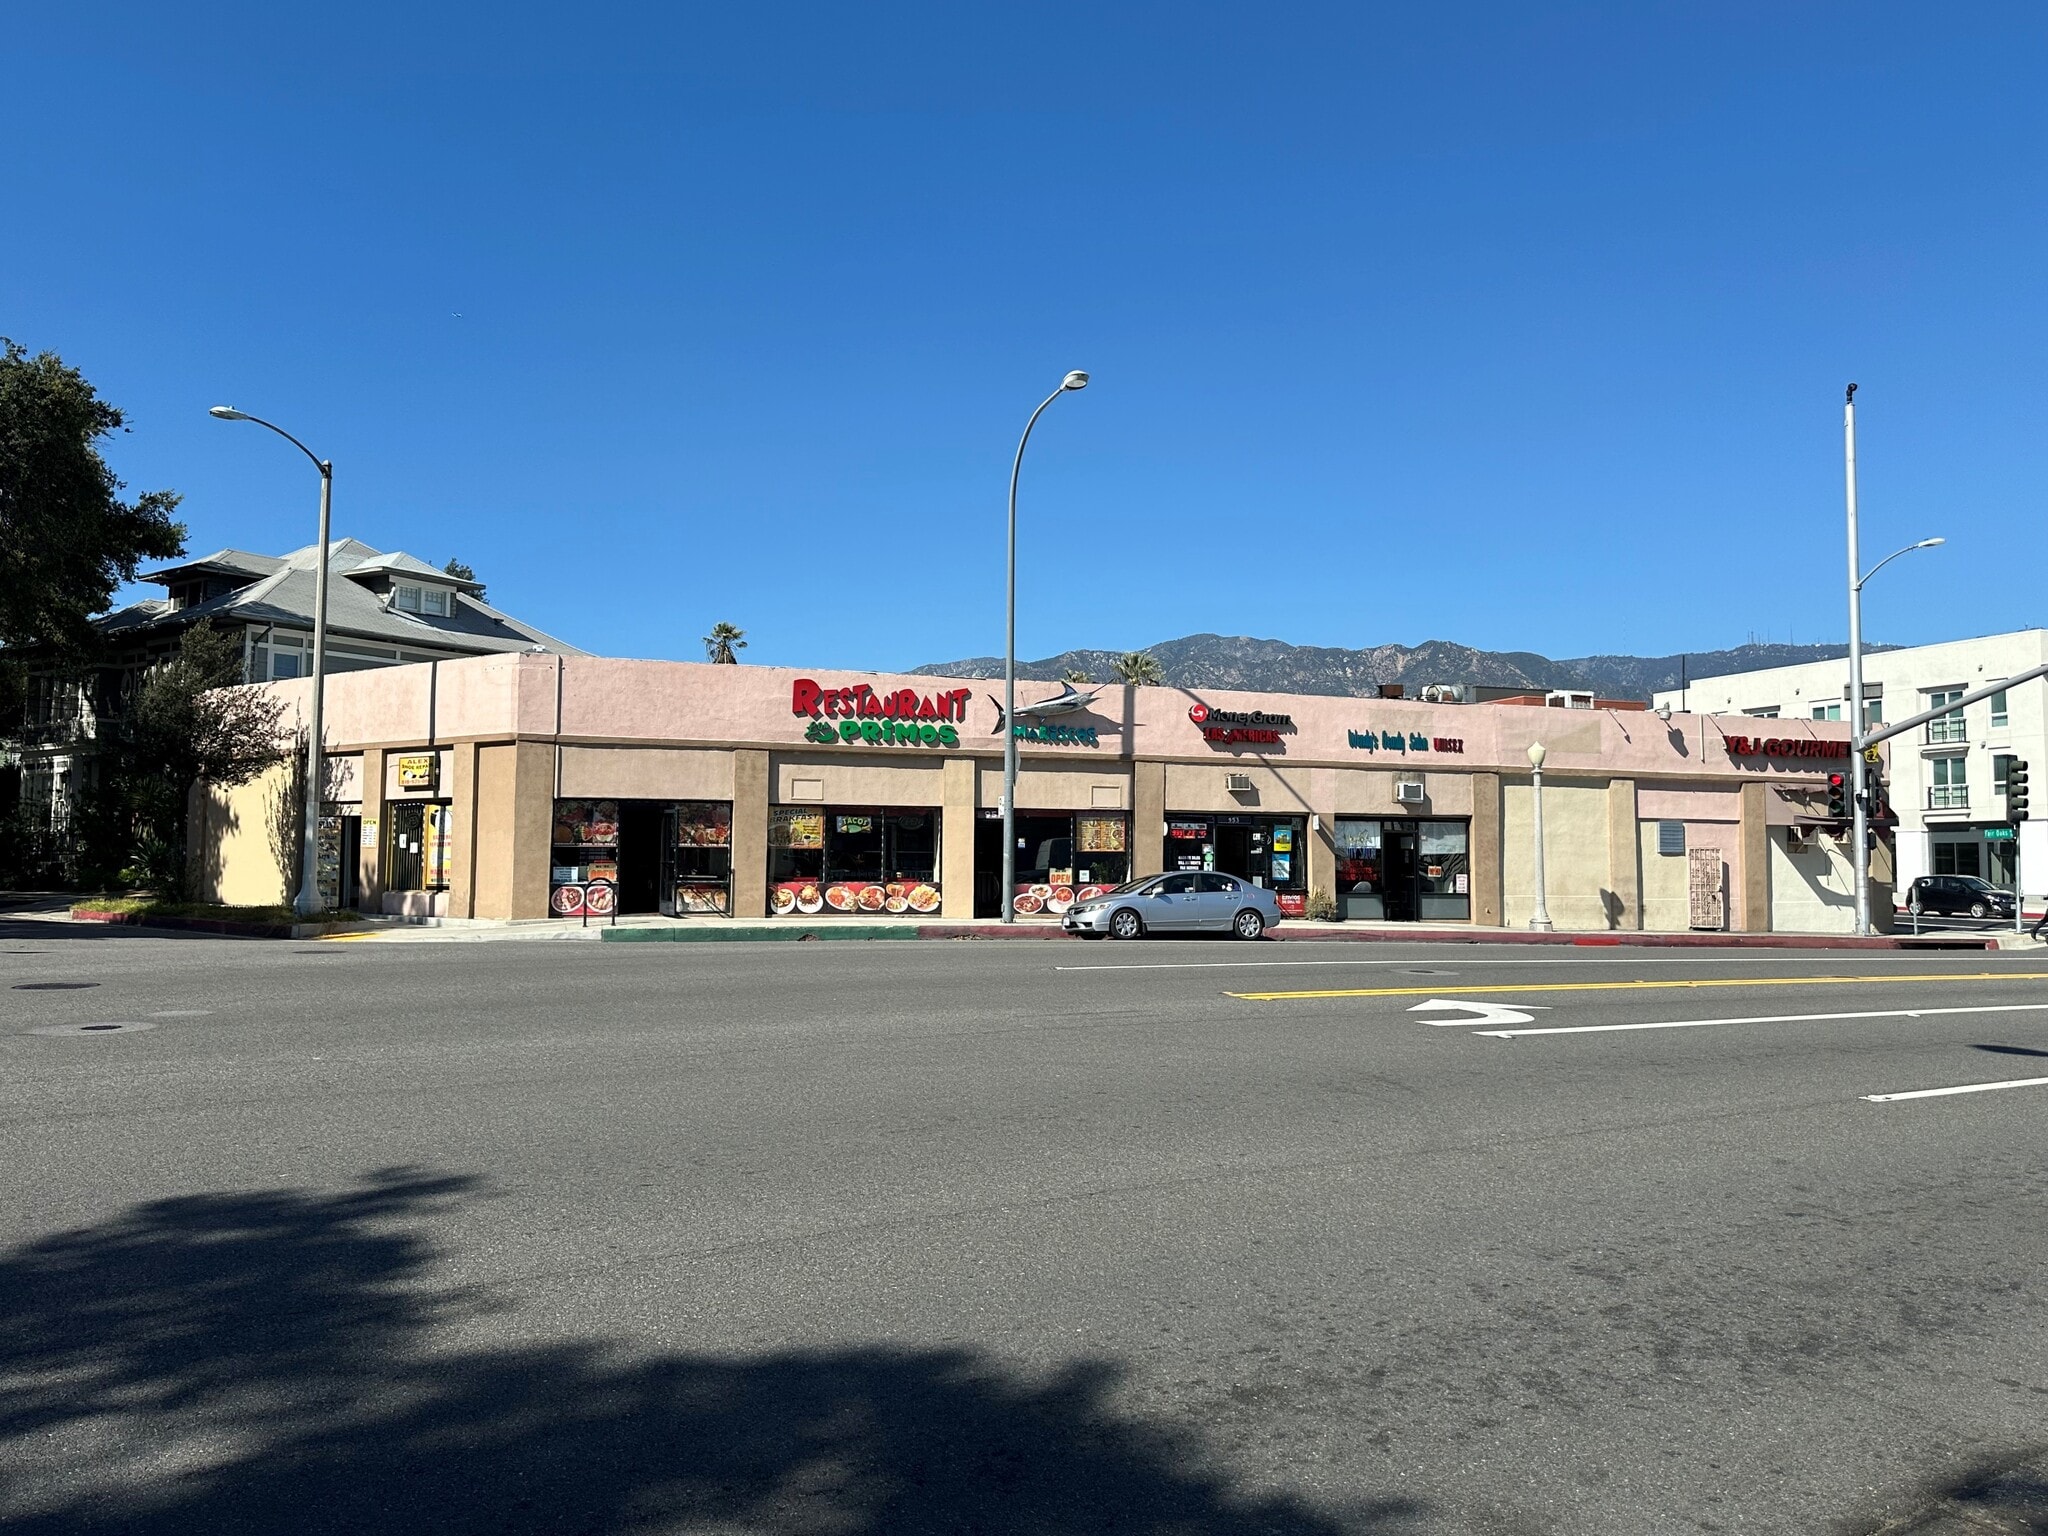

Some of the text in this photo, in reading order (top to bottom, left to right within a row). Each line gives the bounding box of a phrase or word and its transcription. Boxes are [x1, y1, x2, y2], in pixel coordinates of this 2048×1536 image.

[792, 678, 971, 721] RESTAURANT
[1208, 708, 1291, 726] MoneyGram
[1203, 727, 1280, 745] LAS AMERICAS
[1433, 737, 1464, 754] UNISEX
[1723, 735, 1761, 756] Y&J
[774, 808, 808, 816] SPECIAL
[842, 816, 868, 826] TACOS
[1051, 873, 1071, 884] OPEN
